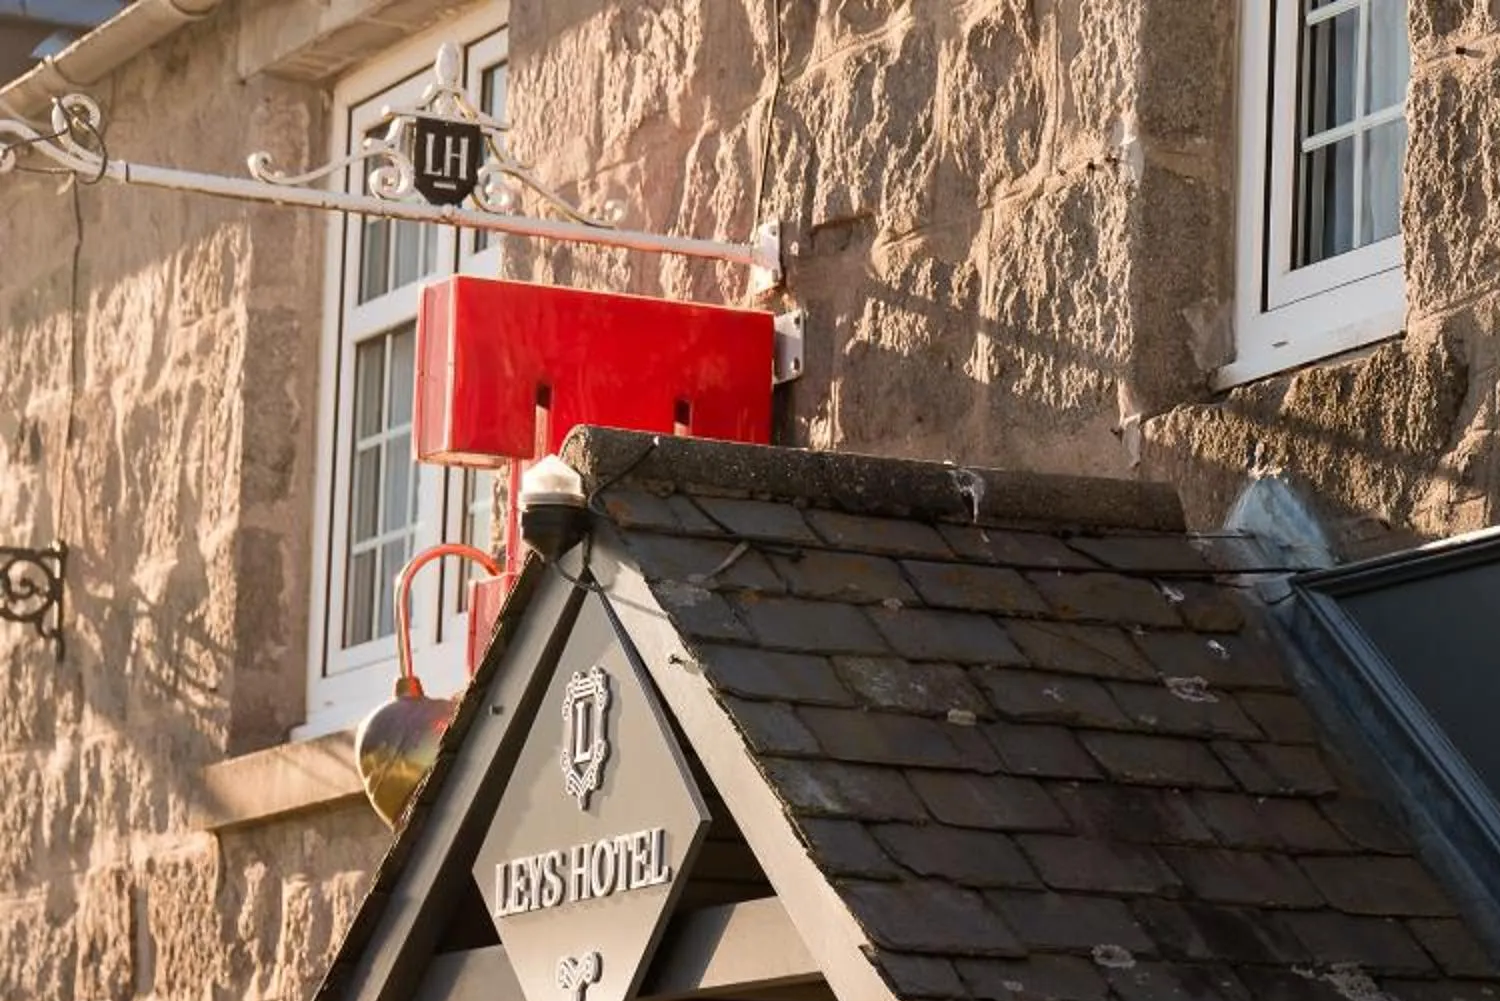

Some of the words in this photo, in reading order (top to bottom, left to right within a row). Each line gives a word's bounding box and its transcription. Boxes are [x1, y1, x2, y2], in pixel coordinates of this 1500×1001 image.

[423, 132, 469, 181] LH
[493, 848, 565, 919] LEYS
[569, 827, 673, 902] HOTEL
